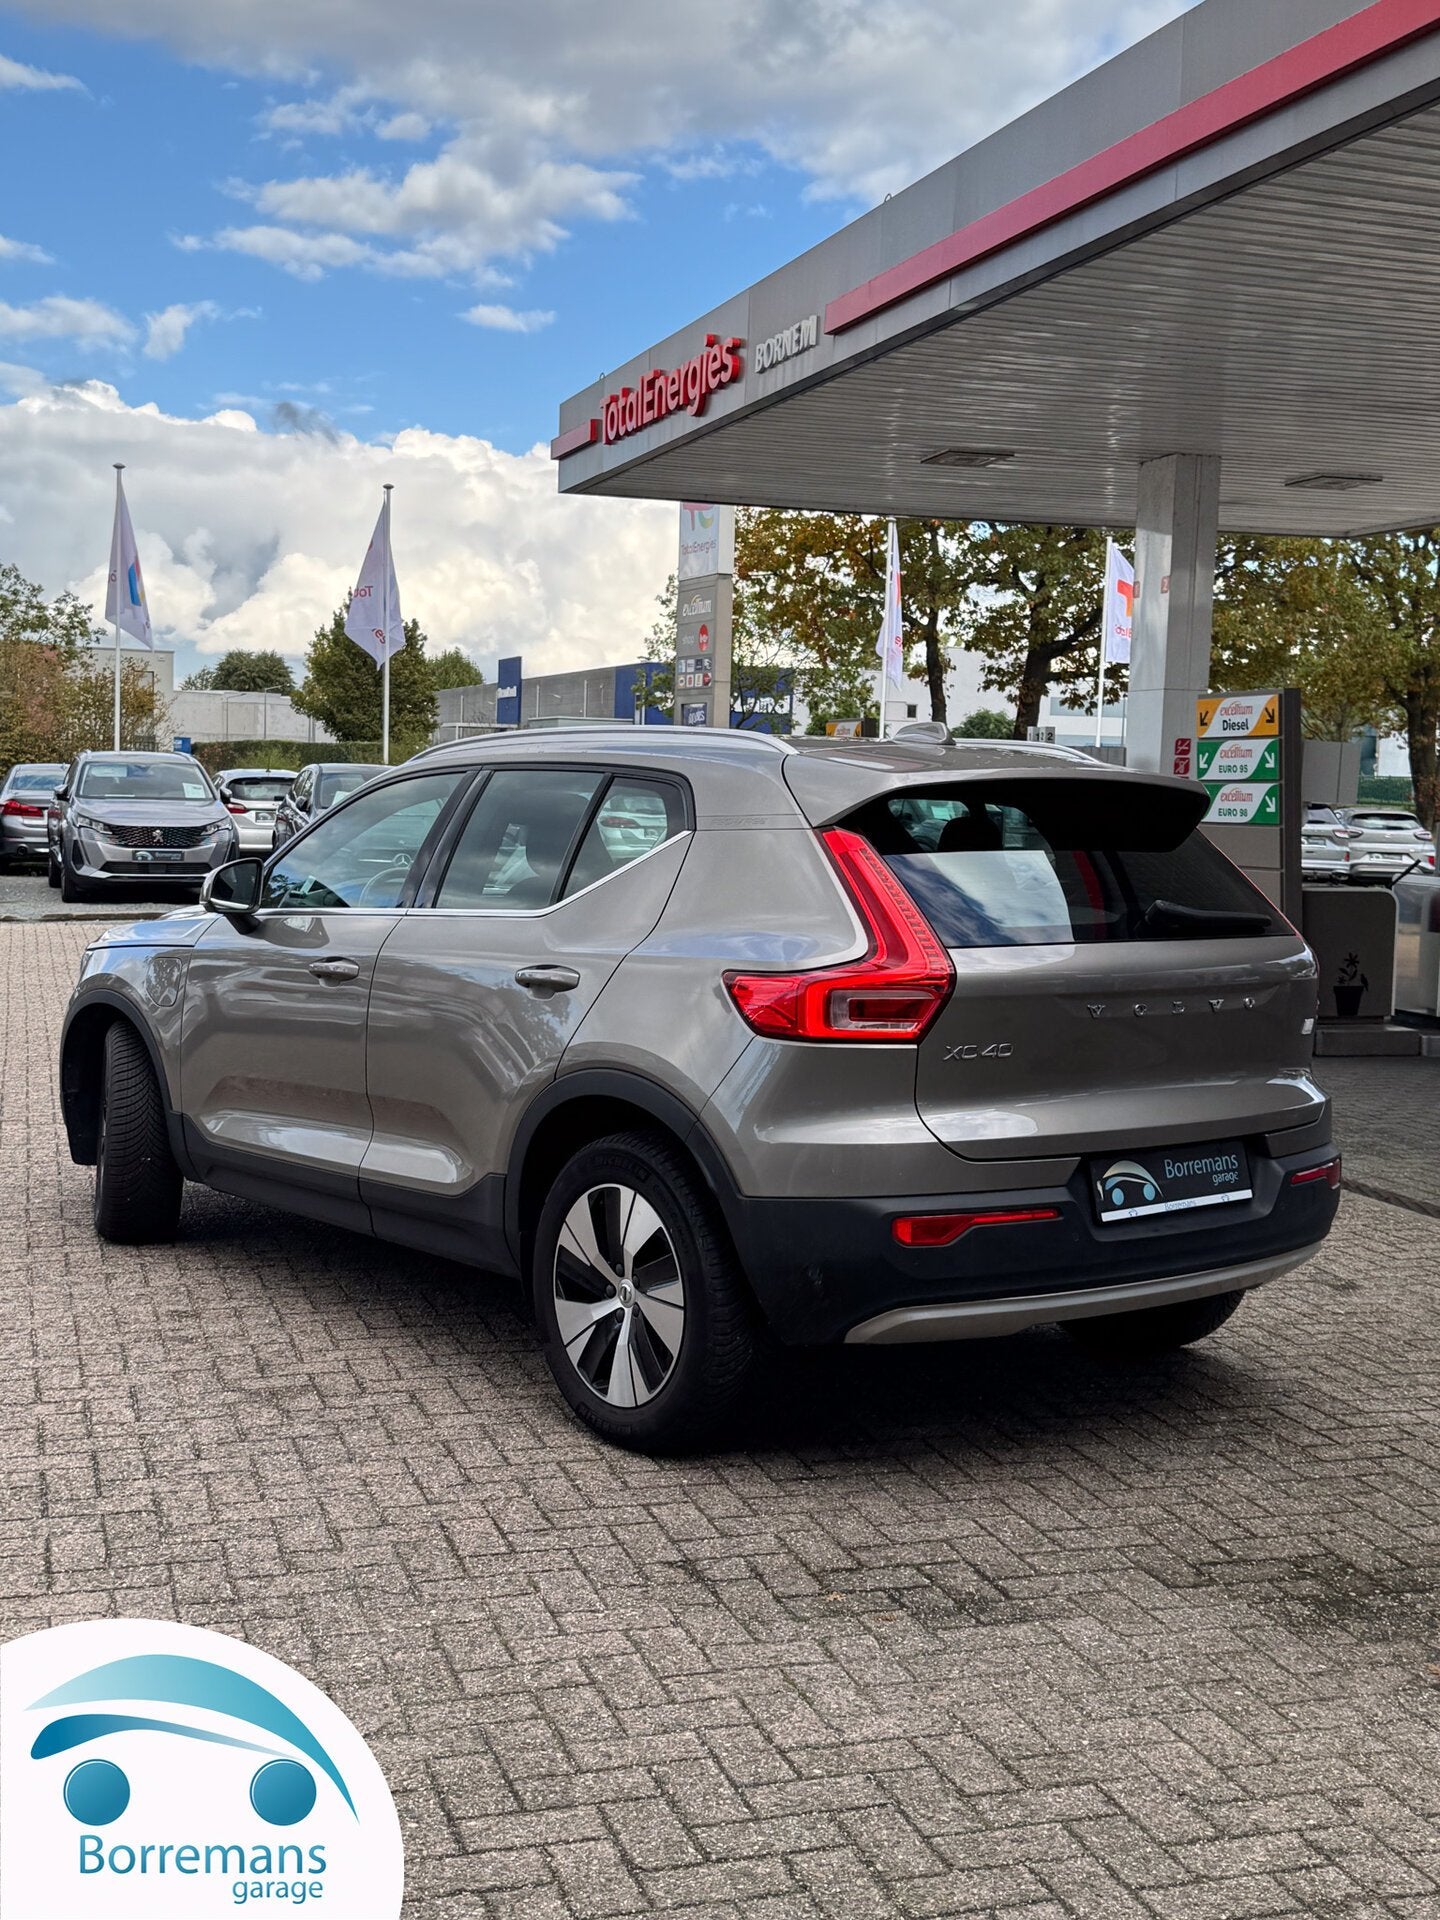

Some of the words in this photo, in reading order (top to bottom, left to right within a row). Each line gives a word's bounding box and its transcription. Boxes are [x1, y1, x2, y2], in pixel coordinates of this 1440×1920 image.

[755, 315, 819, 374] BORNEM
[601, 335, 741, 444] TotalEnergies
[1222, 718, 1249, 731] Diesel
[1218, 765, 1237, 774] EURO
[1239, 764, 1249, 773] 95
[1218, 808, 1237, 817] EURO
[1239, 808, 1248, 817] 98
[1087, 996, 1256, 1019] VOLVO
[1164, 1154, 1239, 1179] Borremans
[1212, 1171, 1239, 1186] garage
